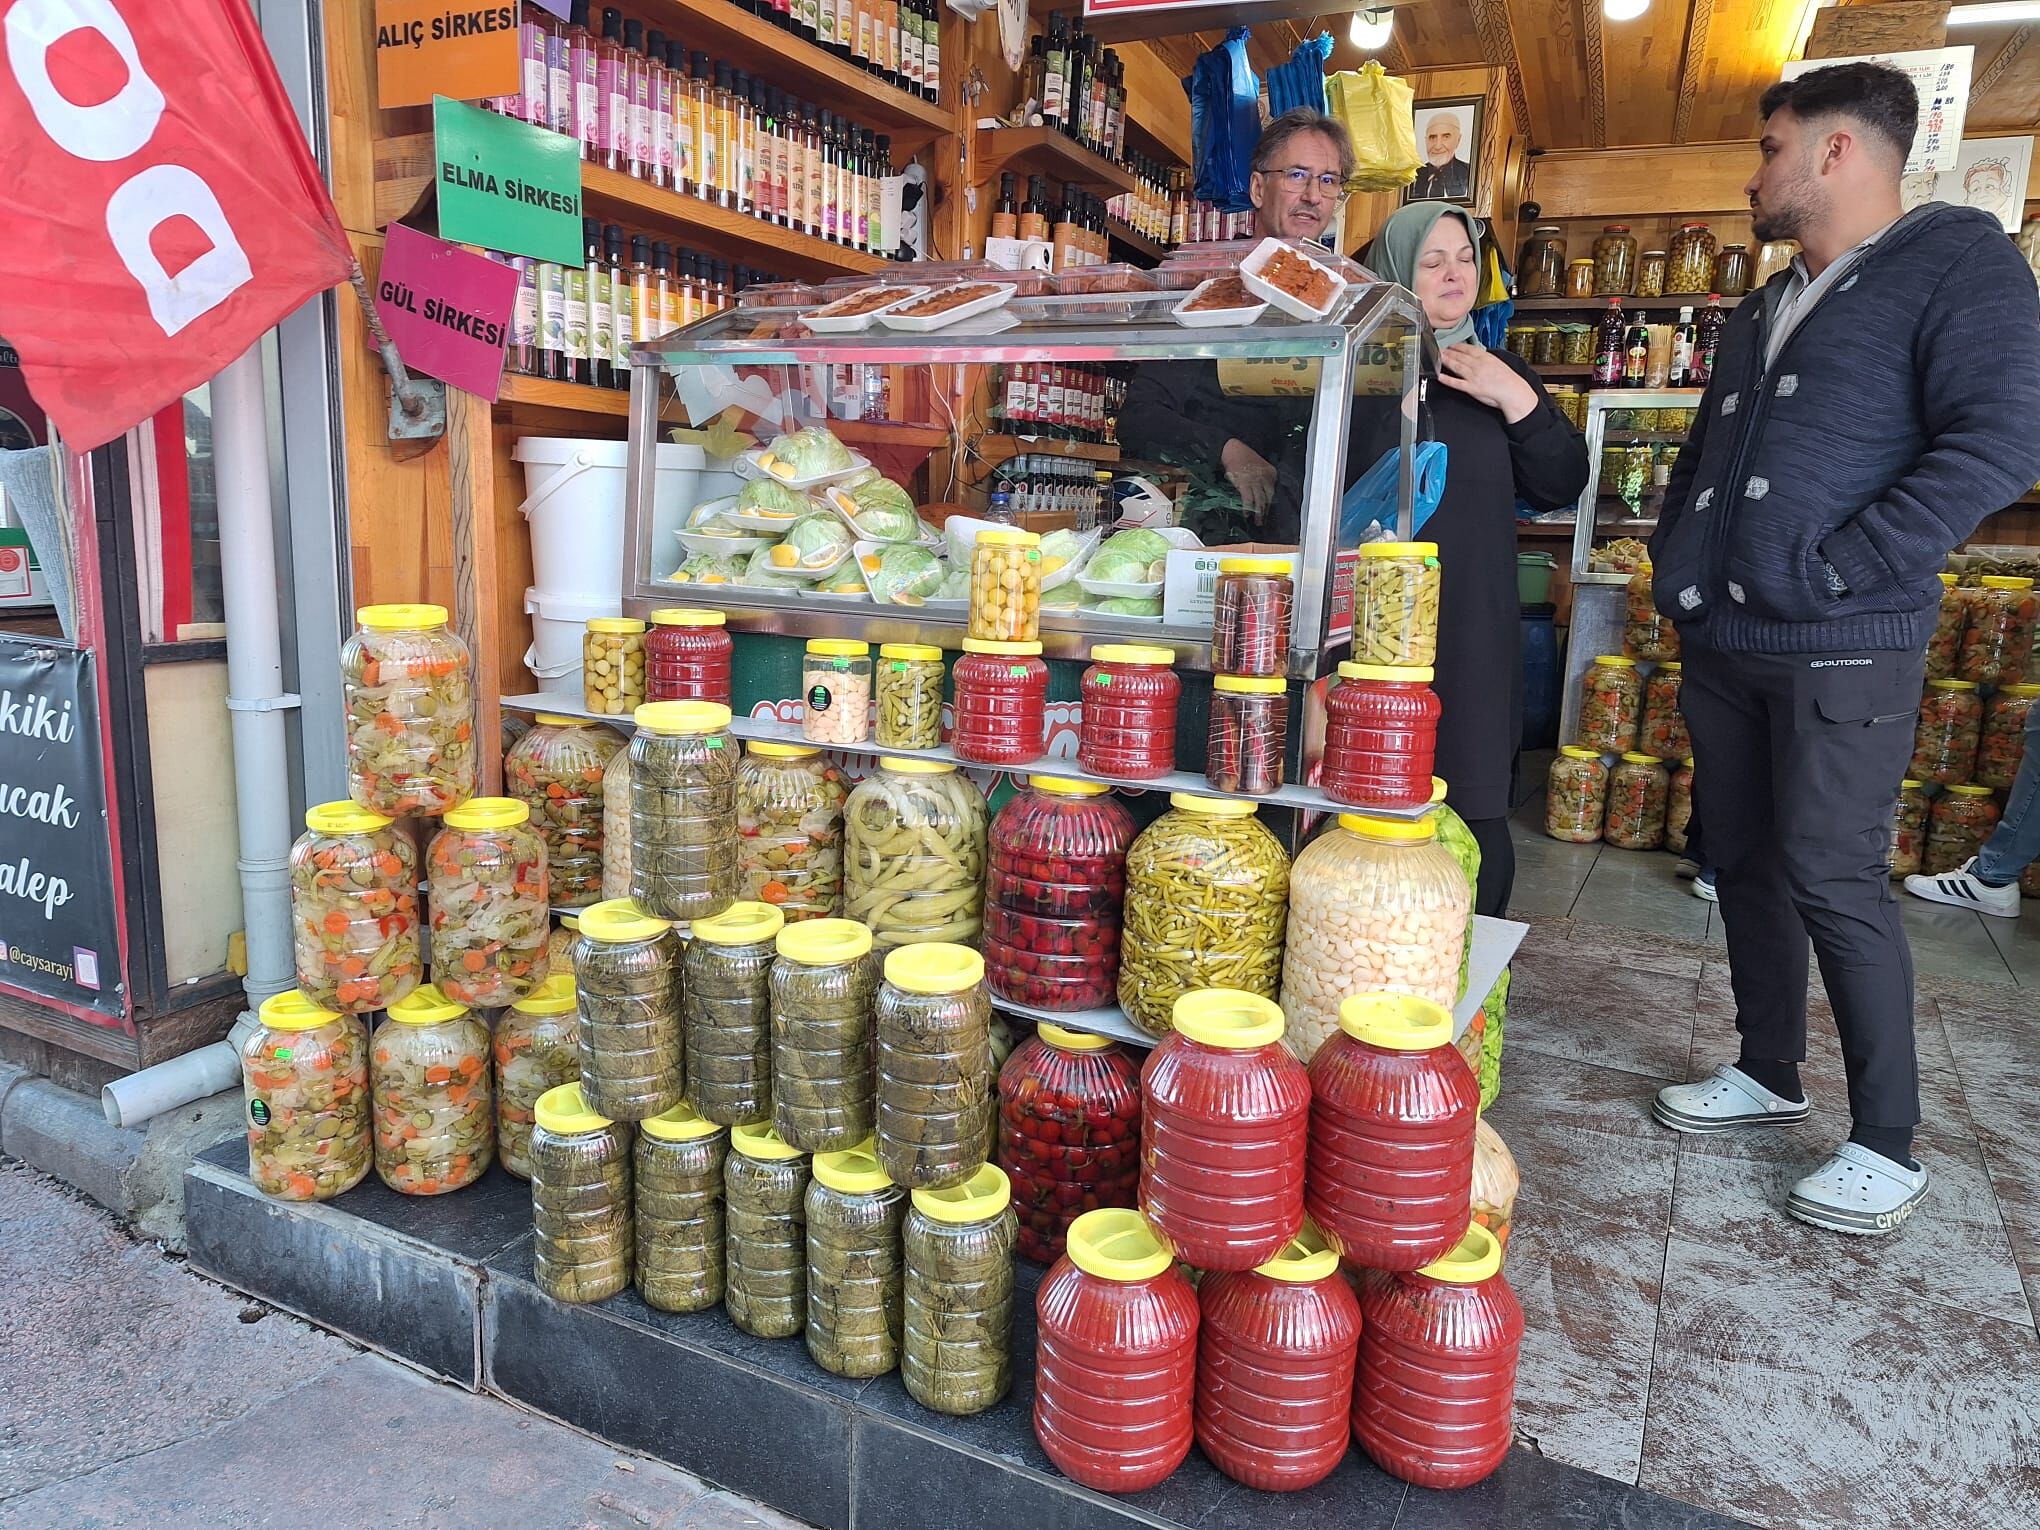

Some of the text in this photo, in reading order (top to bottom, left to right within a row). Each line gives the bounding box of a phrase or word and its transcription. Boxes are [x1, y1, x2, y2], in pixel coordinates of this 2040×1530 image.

[377, 1, 519, 49] ALIÇ SİRKESİ
[442, 161, 579, 217] ELMA SİRKESİ
[380, 280, 506, 349] GÜL SİRKESİ
[0, 690, 75, 744] kiki
[0, 857, 75, 920] alep
[9, 945, 74, 982] @caysarayi
[1876, 1200, 1914, 1229] crocs
